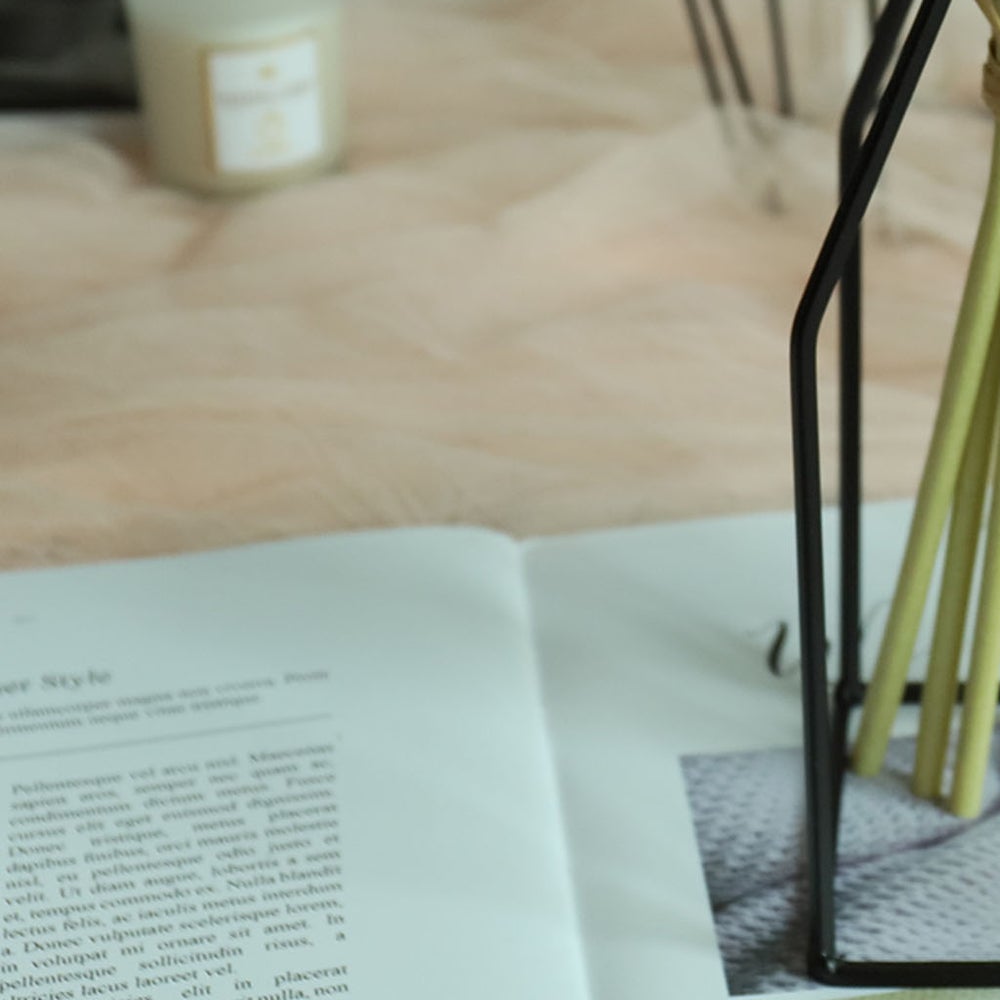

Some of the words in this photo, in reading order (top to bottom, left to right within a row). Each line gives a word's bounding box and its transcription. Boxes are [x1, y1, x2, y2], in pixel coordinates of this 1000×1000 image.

[24, 936, 83, 952] Donec
[88, 922, 174, 944] vulputate
[179, 907, 280, 930] scelerisque
[31, 950, 108, 968] volutpat
[120, 944, 145, 956] mi
[157, 933, 217, 950] ornare
[325, 913, 345, 924] In
[0, 965, 117, 994] pellentesque
[138, 947, 243, 970] sollicitudin
[81, 980, 129, 994] lacus
[135, 968, 197, 986] laoreet
[180, 984, 211, 1000] elit
[233, 979, 252, 990] in
[273, 964, 347, 990] placerat
[314, 984, 348, 996] non
